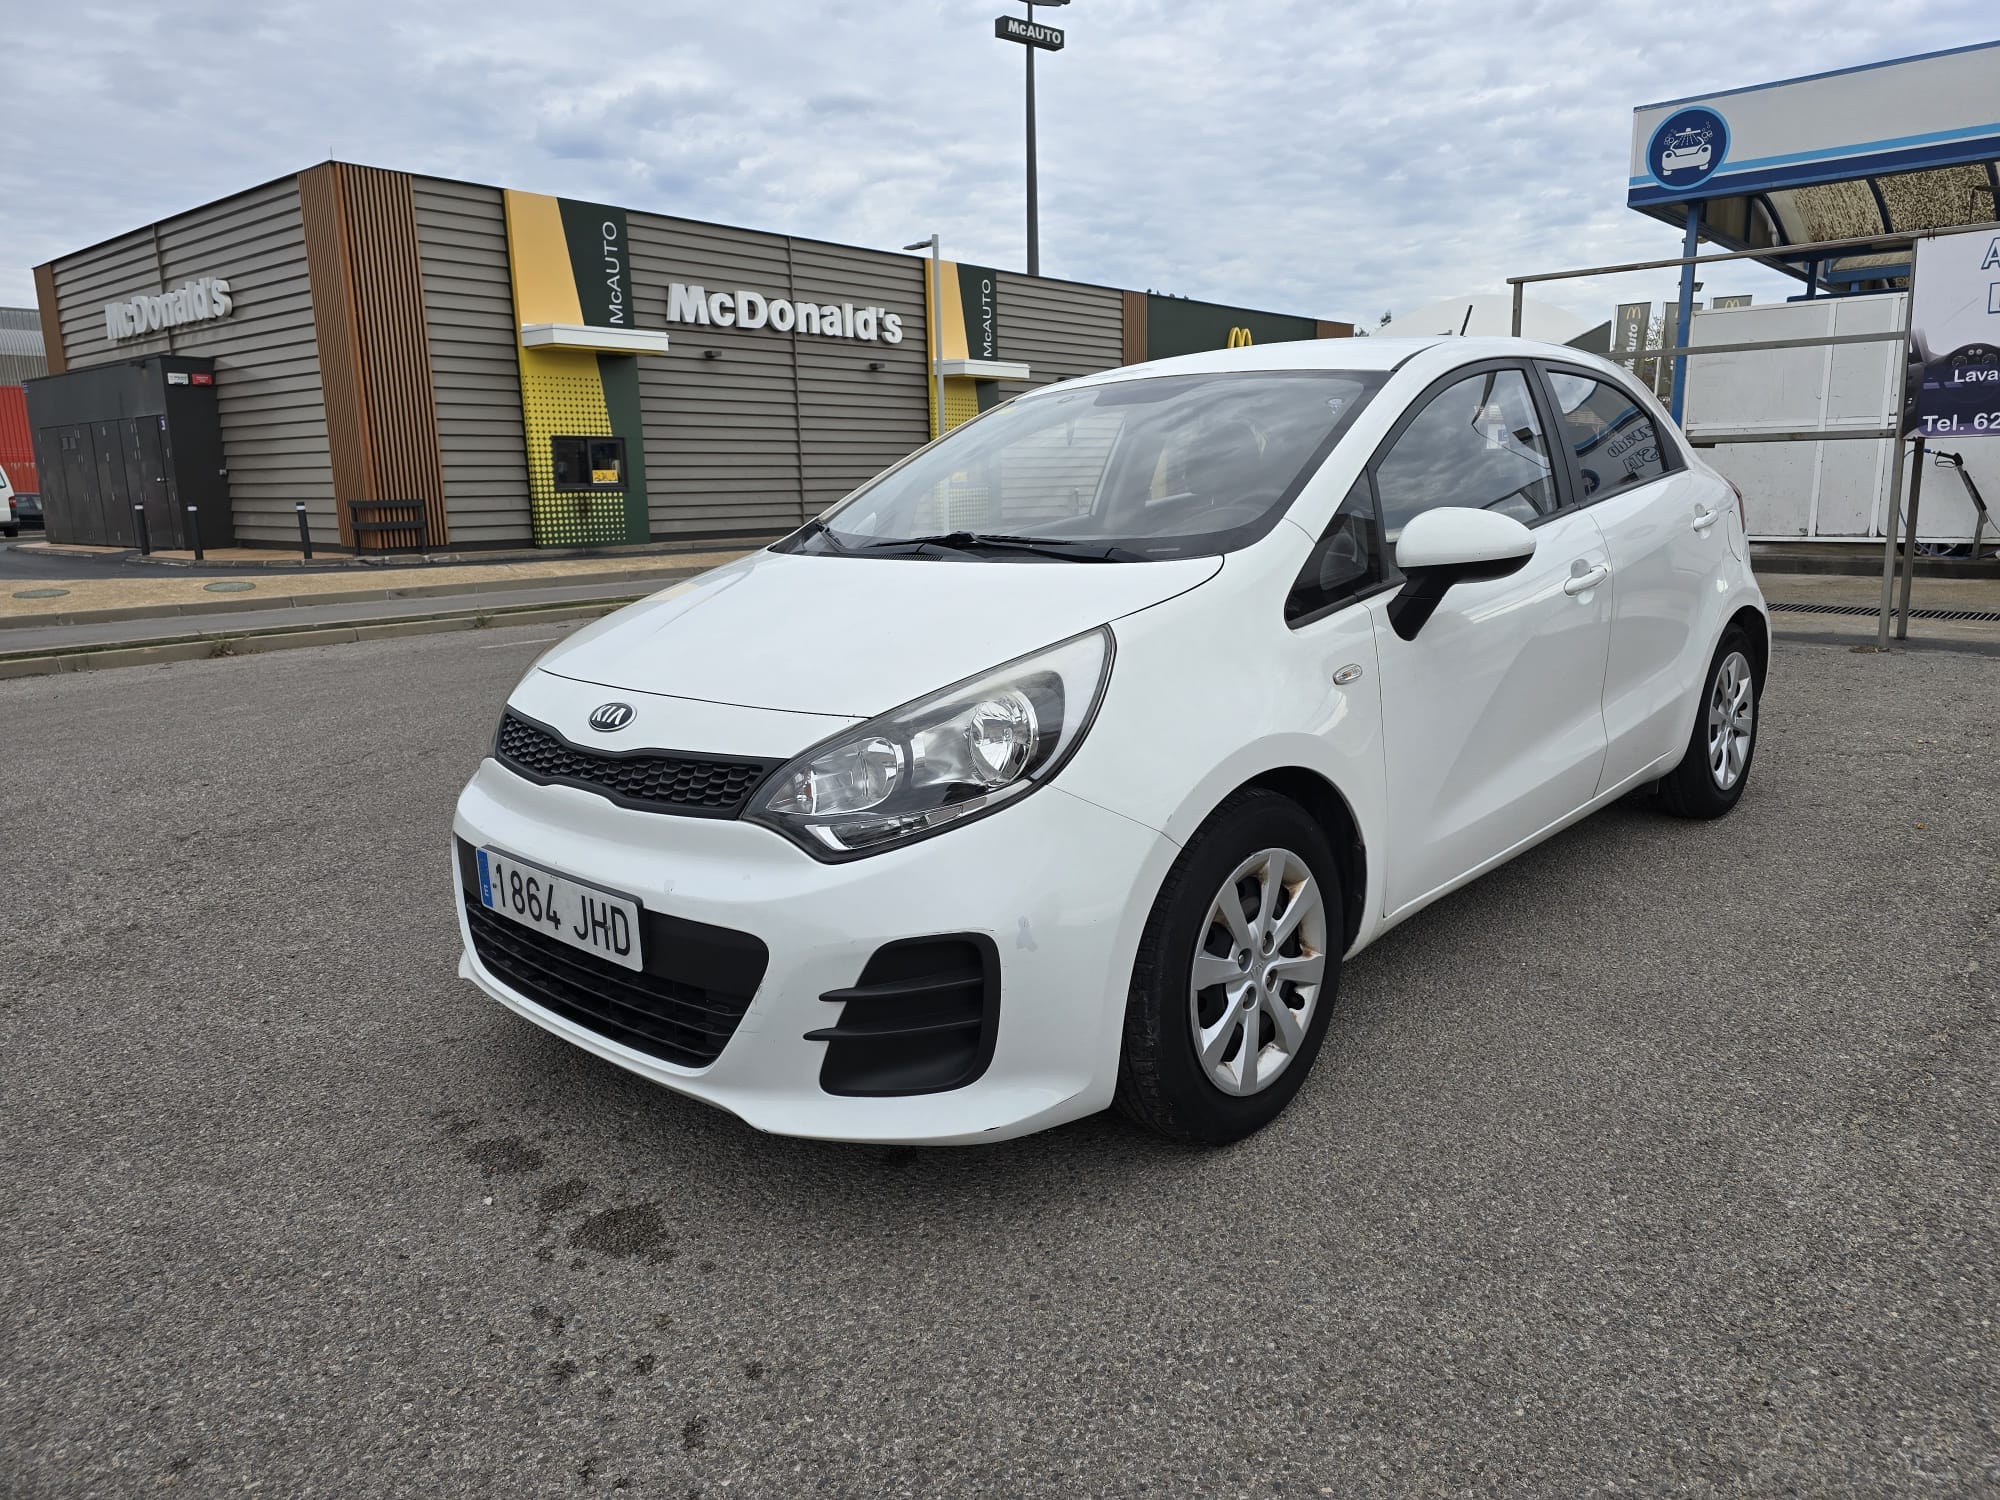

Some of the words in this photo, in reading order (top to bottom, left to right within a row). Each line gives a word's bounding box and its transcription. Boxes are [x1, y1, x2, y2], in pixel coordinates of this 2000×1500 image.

[1007, 20, 1061, 44] McAUTO
[602, 221, 624, 324] McAUTO
[105, 276, 233, 341] McDonald's
[666, 283, 904, 345] McDonald's
[981, 279, 993, 357] McAUTO
[1922, 413, 1965, 433] Tel.
[591, 705, 627, 726] KIA
[495, 863, 561, 931] 1864
[573, 895, 631, 957] JHD
